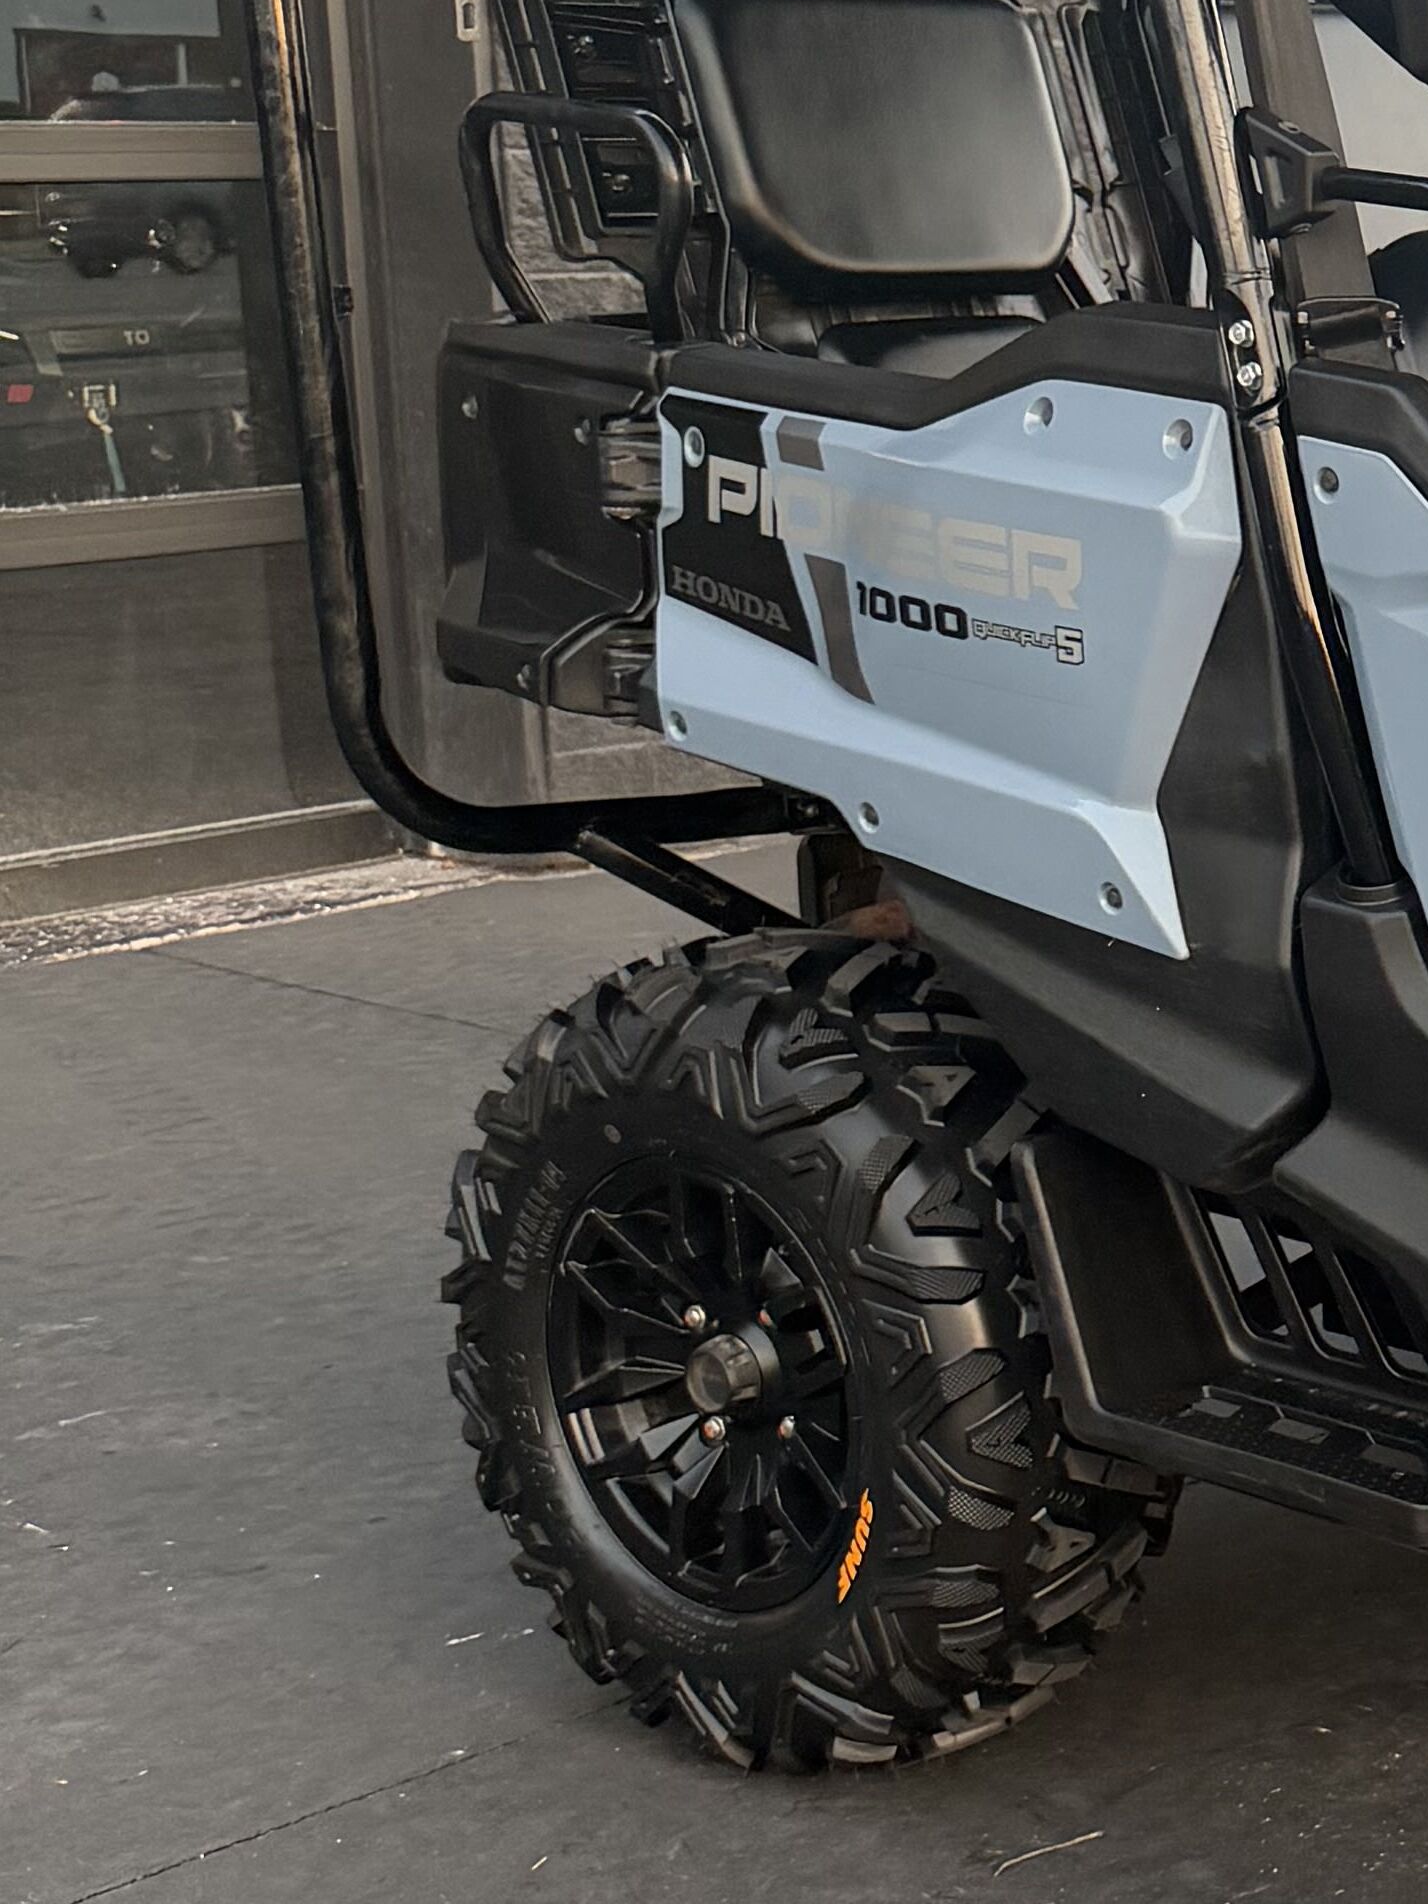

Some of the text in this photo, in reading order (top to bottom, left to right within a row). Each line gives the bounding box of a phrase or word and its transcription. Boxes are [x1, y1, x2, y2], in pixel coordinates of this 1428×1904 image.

[707, 454, 1083, 612] PIOEER
[671, 564, 793, 633] HONDA
[856, 580, 970, 641] 1000
